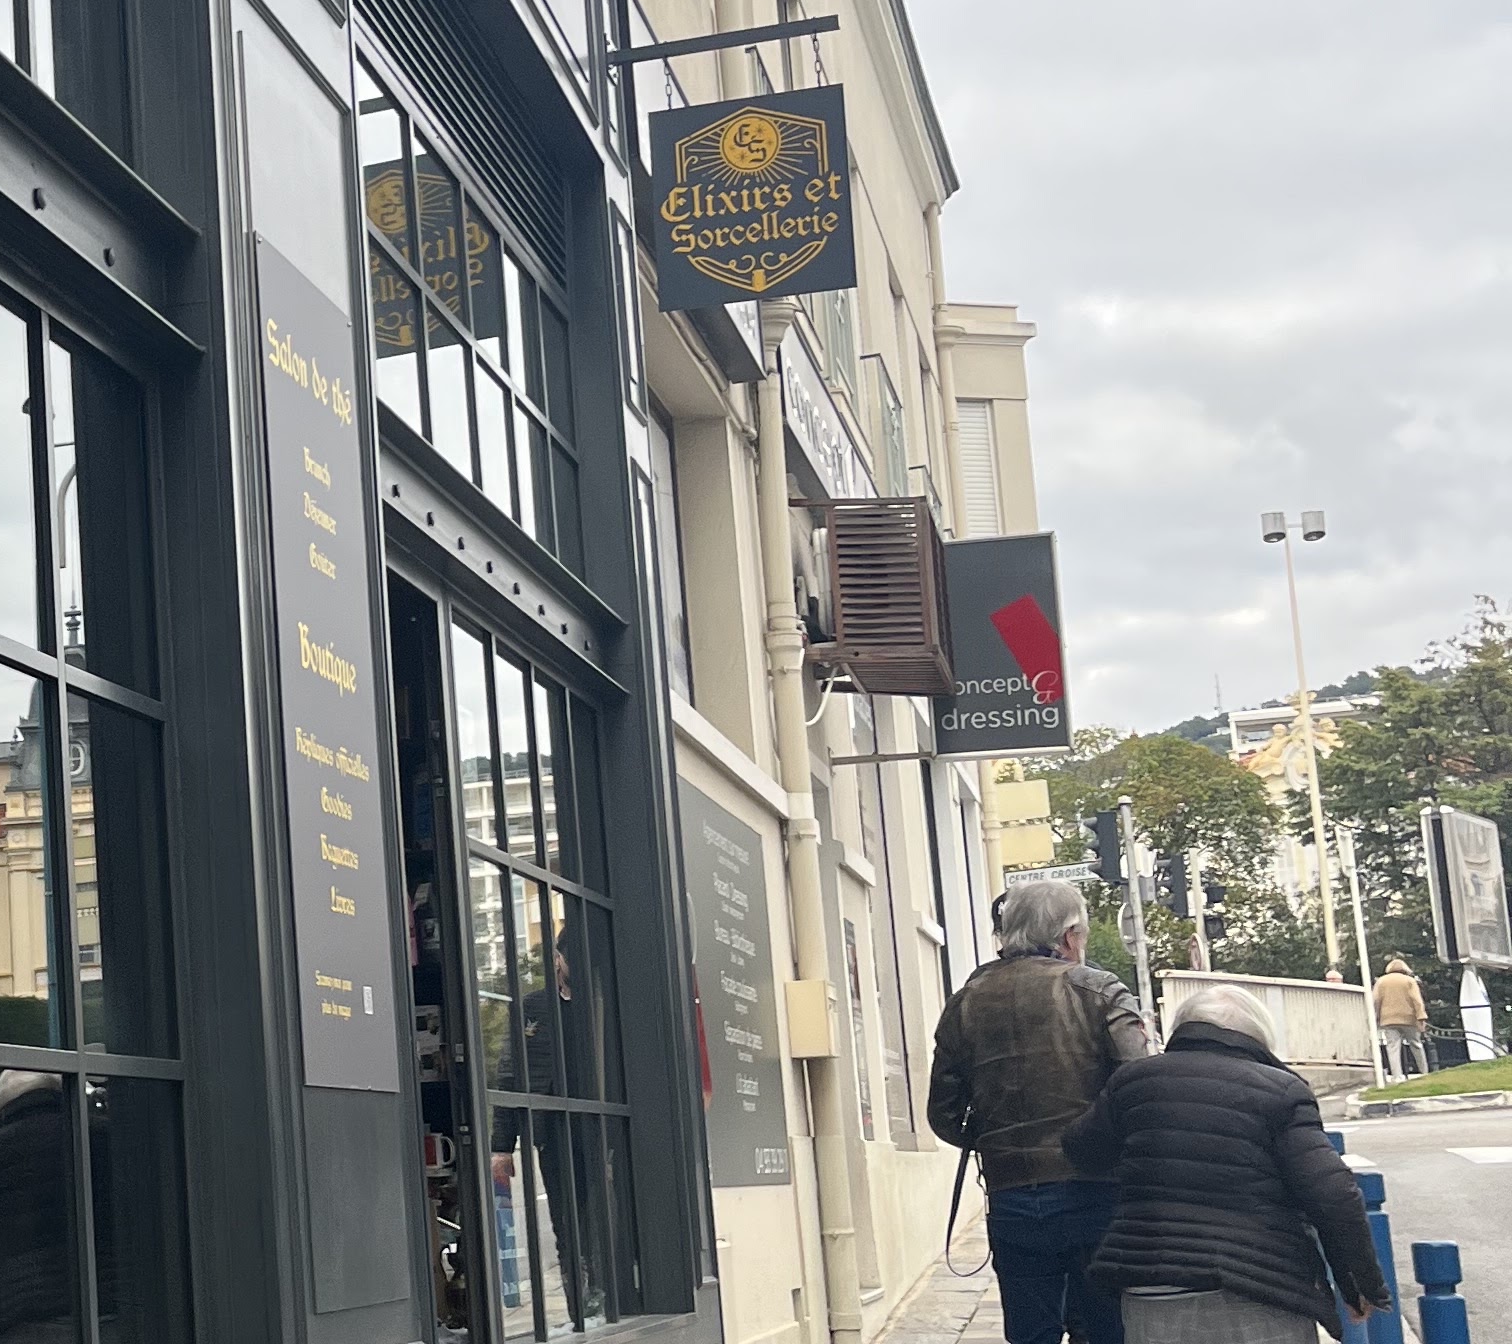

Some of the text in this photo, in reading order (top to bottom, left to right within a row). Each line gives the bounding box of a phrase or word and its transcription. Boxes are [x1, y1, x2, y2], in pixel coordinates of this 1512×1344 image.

[660, 170, 843, 223] Elixirs et
[671, 207, 839, 254] Sorcellerie
[266, 317, 352, 428] Salon de thé
[303, 446, 331, 491] Brunch
[297, 621, 357, 698] Boutique
[955, 672, 1031, 696] oncept
[941, 703, 1060, 731] dressing
[320, 786, 353, 821] Goodies
[1008, 866, 1093, 884] CENTRE CROISE
